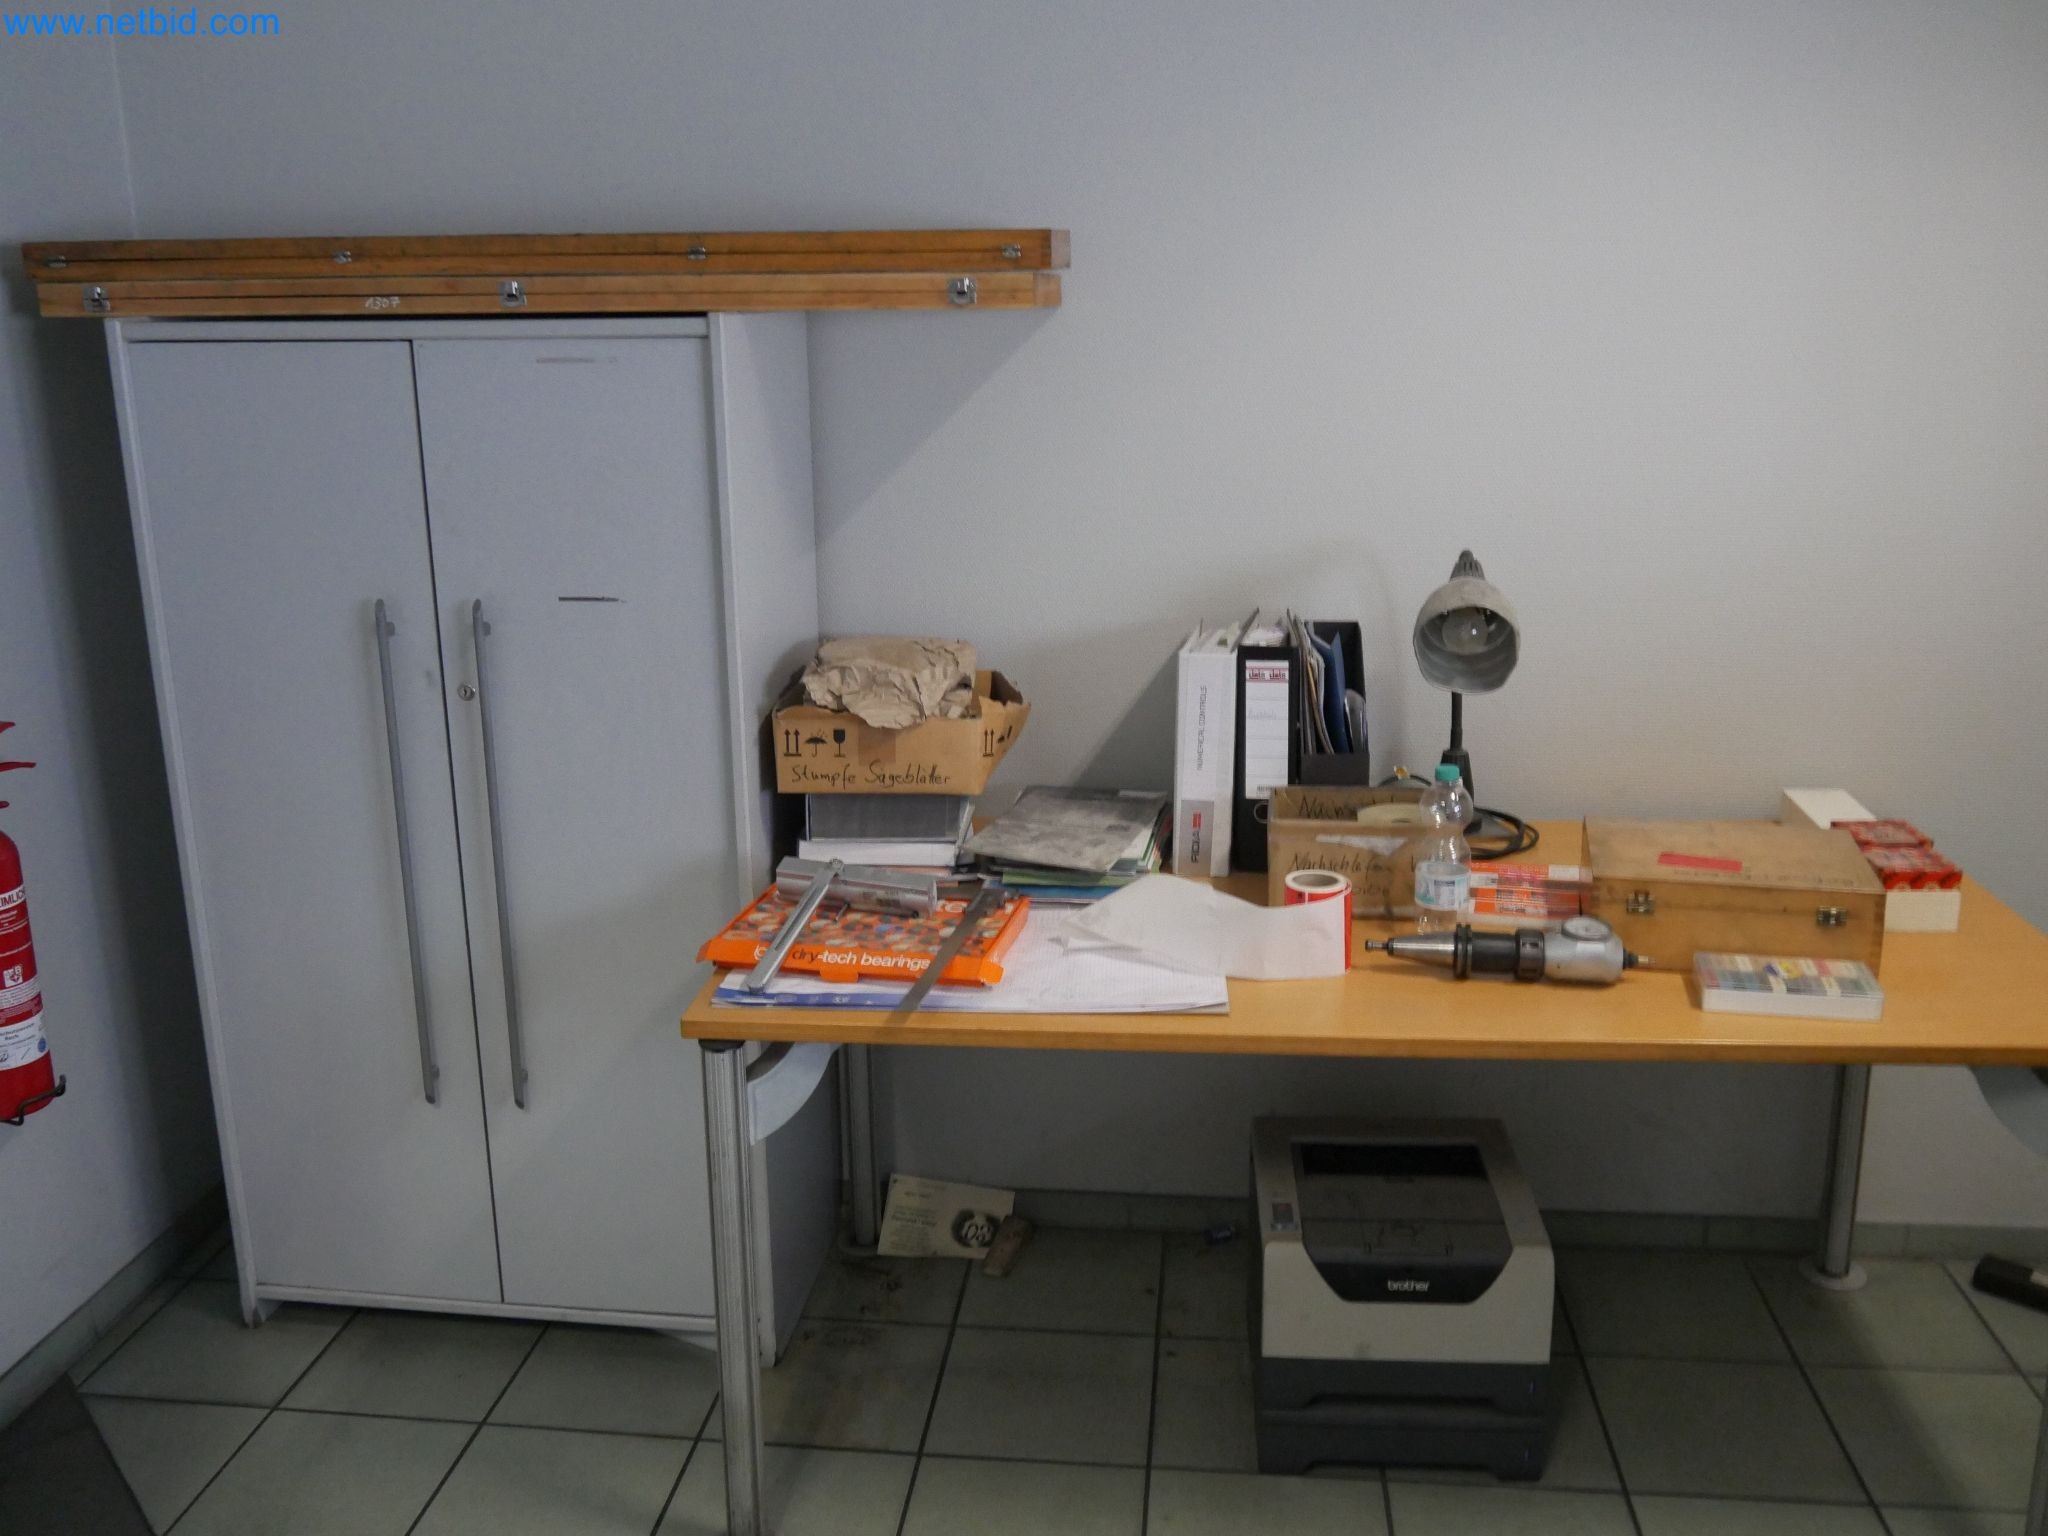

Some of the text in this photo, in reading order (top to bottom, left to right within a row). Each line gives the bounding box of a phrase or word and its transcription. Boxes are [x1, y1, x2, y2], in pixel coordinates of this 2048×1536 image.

[791, 763, 856, 790] Stumpfe
[792, 948, 931, 971] dry-tech bearings
[1387, 1279, 1430, 1292] brother
